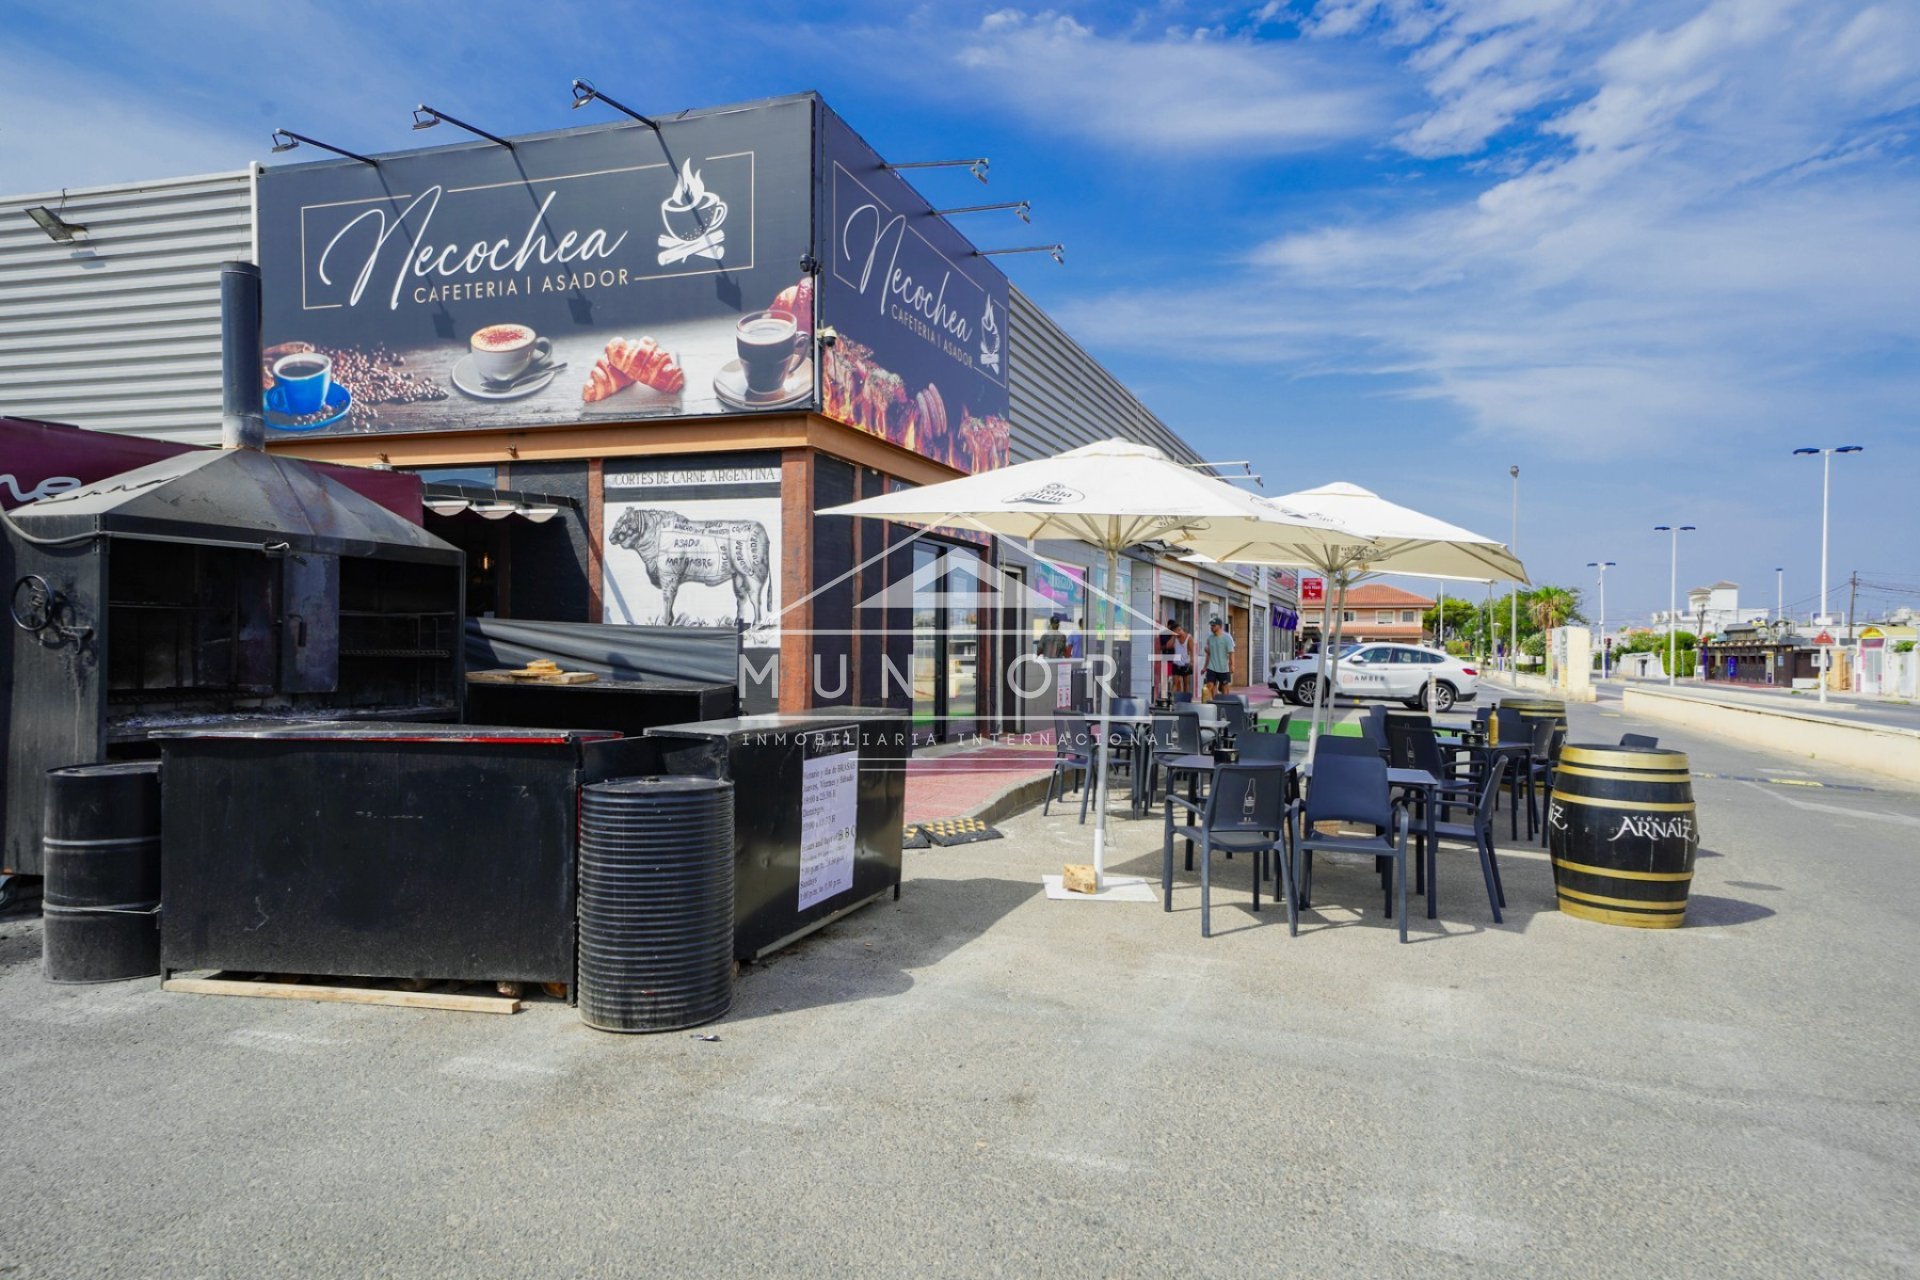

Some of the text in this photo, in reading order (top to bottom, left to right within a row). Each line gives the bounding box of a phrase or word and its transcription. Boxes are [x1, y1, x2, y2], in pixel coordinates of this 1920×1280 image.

[319, 184, 629, 310] Necochea
[843, 204, 973, 316] Necochea
[414, 278, 518, 304] CAFETERIA
[542, 269, 629, 291] ASADOR
[890, 304, 936, 342] CAFETERIA
[943, 341, 973, 369] ASADOR
[657, 472, 670, 485] DE
[672, 470, 706, 484] CARNE
[710, 468, 775, 483] ARGENTINA
[674, 539, 701, 548] ASADO
[666, 557, 713, 569] MATAMBRE
